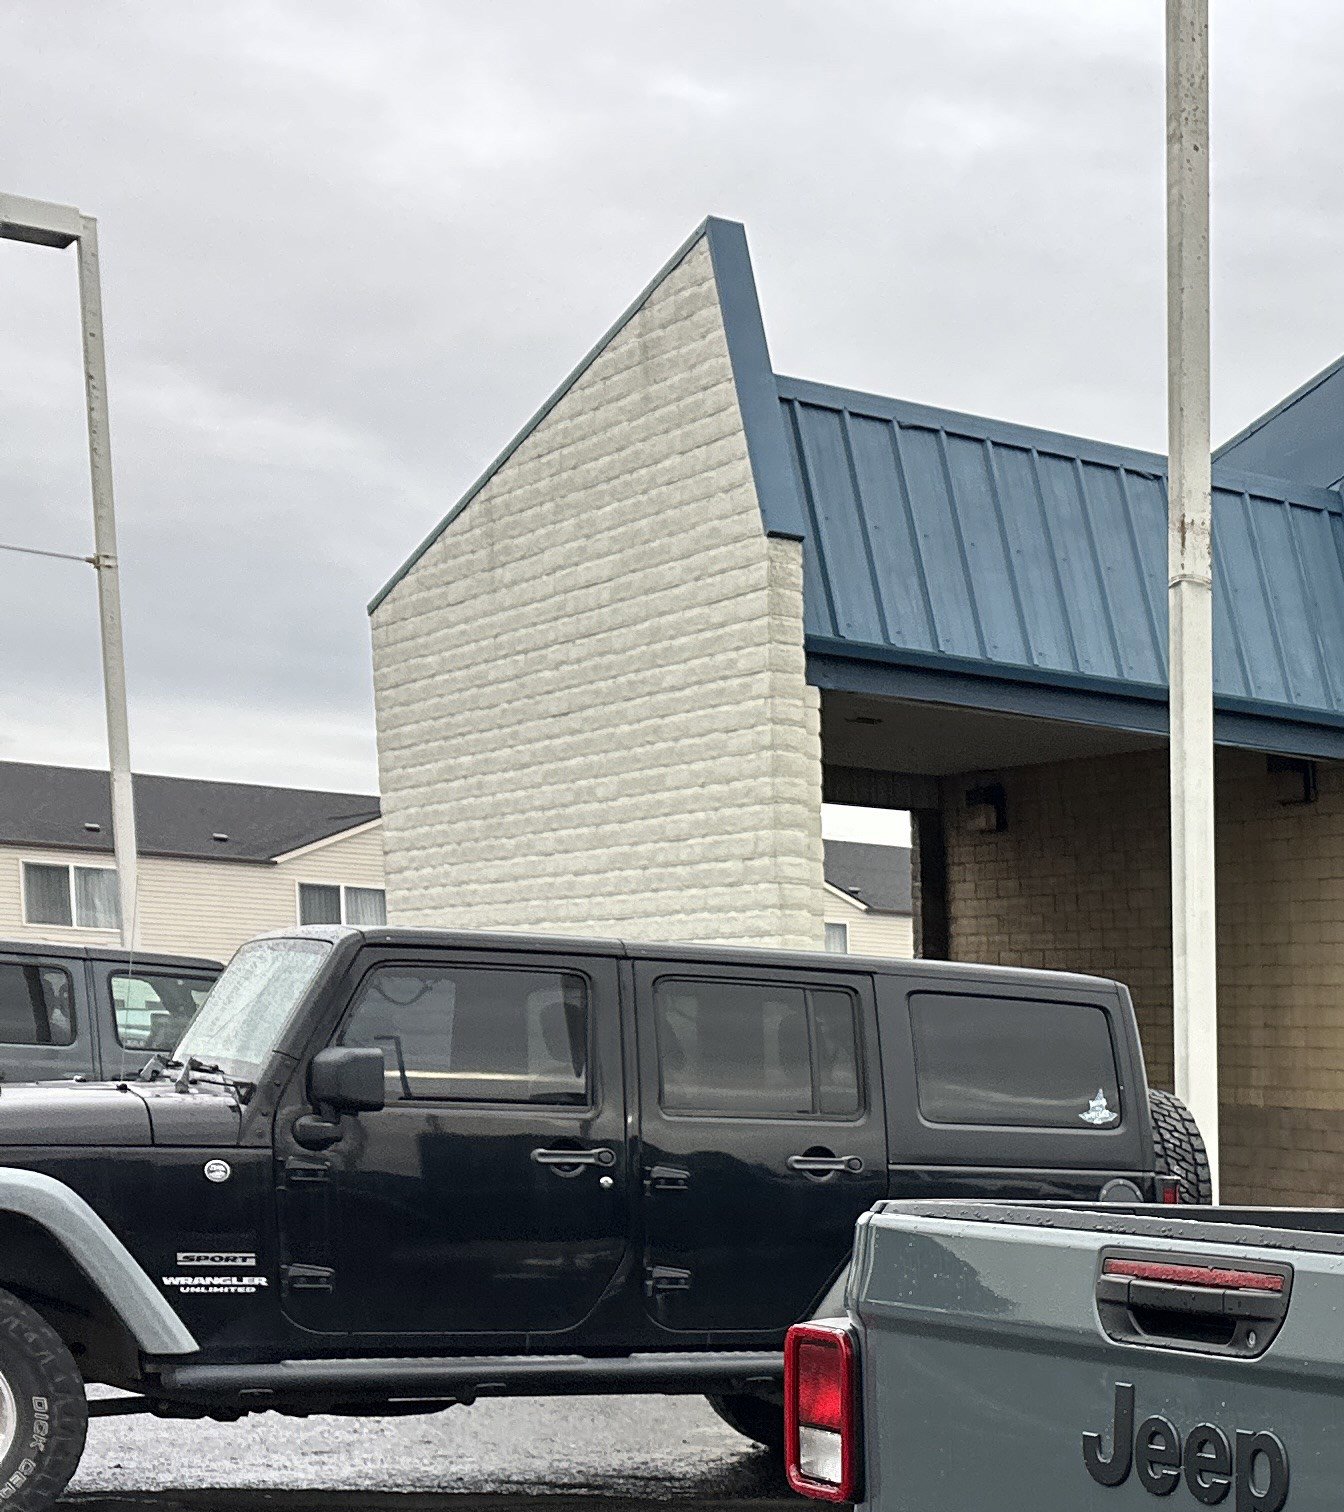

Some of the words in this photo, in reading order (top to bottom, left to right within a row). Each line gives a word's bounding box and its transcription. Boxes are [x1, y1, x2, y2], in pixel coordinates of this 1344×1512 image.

[180, 1254, 254, 1263] SPORT
[162, 1276, 269, 1286] WRANGLER
[30, 1395, 49, 1452] DICK
